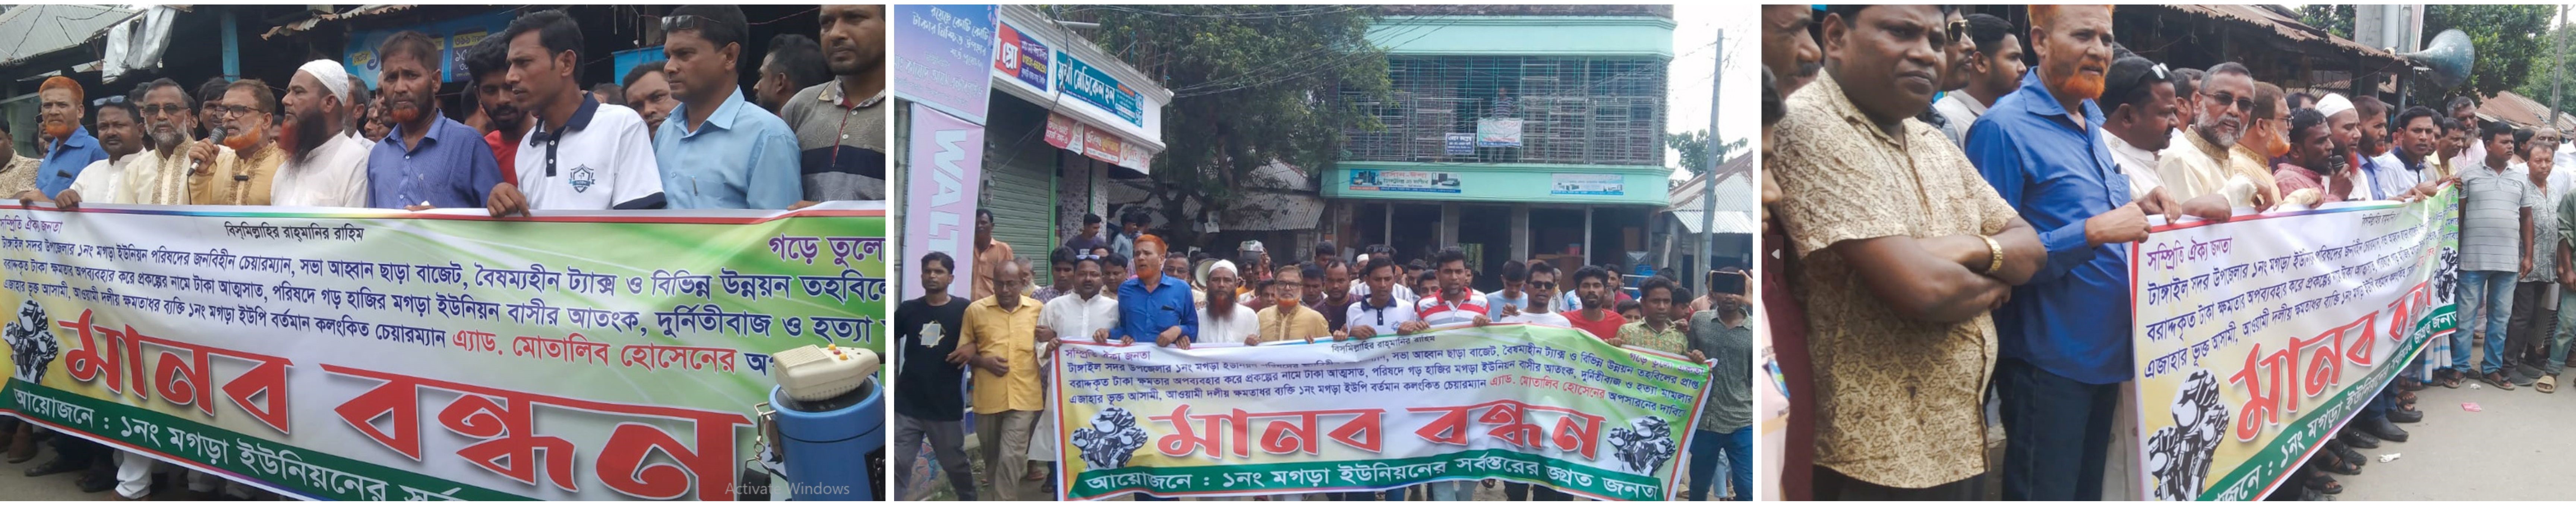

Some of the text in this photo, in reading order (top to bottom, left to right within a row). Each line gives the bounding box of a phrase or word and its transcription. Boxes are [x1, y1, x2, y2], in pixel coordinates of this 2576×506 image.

[40, 221, 63, 234] জনতা
[333, 223, 364, 242] রাহিম
[769, 233, 821, 265] গড়ে
[2188, 236, 2208, 263] ঐক্য
[1, 236, 23, 252] টাঙ্গাইল
[26, 240, 42, 252] সদর
[44, 237, 75, 257] উপজেলার
[78, 243, 93, 259] ১নং
[97, 245, 115, 262] মগড়া
[116, 243, 148, 263] ইউনিয়ন
[151, 245, 190, 265] পরিষদের
[194, 248, 236, 271] জনবিহীন
[239, 255, 295, 278] চেয়ারম্যান,
[299, 258, 323, 276] সভা
[378, 262, 410, 285] ছাড়া
[415, 261, 468, 290] বাজেট,
[474, 262, 562, 293] বৈষম্যহীন
[560, 266, 618, 296] ট্যাক্স
[626, 276, 643, 294] ও
[650, 269, 713, 300] বিভিন্ন
[719, 268, 793, 301] উন্নয়ন
[2147, 276, 2188, 306] টাঙ্গাইল
[2190, 273, 2210, 294] সদর
[2252, 261, 2268, 277] ১নং
[31, 258, 48, 274] টাকা
[50, 263, 73, 277] ক্ষমতার
[75, 265, 116, 283] অপব্যবহার
[119, 271, 135, 285] করে
[138, 271, 168, 289] প্রকল্পের
[170, 275, 190, 291] নামে
[193, 274, 215, 294] টাকা
[218, 280, 268, 303] আত্মসাত,
[272, 280, 316, 304] পরিষদে
[321, 287, 341, 310] গড়
[345, 286, 386, 311] হাজির
[391, 295, 431, 318] মগড়া
[436, 292, 501, 323] ইউনিয়ন
[506, 298, 561, 327] বাসীর
[560, 307, 647, 336] আতংক,
[782, 317, 801, 337] ও
[810, 315, 874, 345] হত্যা
[2146, 311, 2196, 342] বরাদ্দকৃত
[2198, 301, 2214, 325] টাকা
[2247, 282, 2287, 304] অপব্যবহার
[2289, 278, 2305, 293] করে
[3, 279, 25, 293] এজাহার
[42, 280, 71, 301] আসামী,
[73, 286, 99, 303] আওয়ামী
[101, 287, 120, 306] দলীয়
[123, 294, 161, 313] ক্ষমতাধর
[164, 296, 185, 315] ব্যক্তি
[188, 303, 206, 320] ১নং
[208, 305, 235, 325] মগড়া
[238, 304, 266, 327] ইউপি
[270, 309, 310, 331] বর্তমান
[314, 314, 370, 337] কলংকিত
[375, 324, 446, 348] চেয়ারম্যান
[513, 332, 611, 367] মোতালিব
[621, 342, 738, 374] হোসেনের
[1067, 362, 1102, 374] টাঙ্গাইল
[1105, 363, 1126, 372] সদর
[1128, 364, 1171, 373] উপজেলার
[1176, 364, 1193, 373] ১নং
[1195, 362, 1219, 372] মগড়া
[1392, 351, 1409, 361] সভা
[1446, 349, 1465, 360] ছাড়া
[1569, 352, 1577, 361] ও
[1580, 351, 1604, 368] বিভিন্ন
[1607, 359, 1634, 375] উন্নয়ন
[1638, 369, 1678, 384] তহবিলের
[1124, 351, 1150, 361] জনতা
[2144, 348, 2188, 378] এজাহার
[2228, 310, 2379, 442] মানব
[1068, 378, 1109, 392] বরাদ্দকৃত
[1112, 376, 1134, 386] টাকা
[1137, 377, 1169, 386] ক্ষমতার
[1173, 377, 1220, 386] অপব্যবহার
[1224, 375, 1242, 384] করে
[1245, 372, 1279, 383] প্রকল্পের
[1281, 370, 1301, 380] নামে
[1304, 369, 1323, 379] টাকা
[1372, 364, 1404, 377] পরিষদে
[1408, 366, 1422, 377] গড়
[1425, 363, 1451, 374] হাজির
[1455, 364, 1478, 375] মগড়া
[1481, 360, 1515, 372] ইউনিয়ন
[1519, 358, 1541, 373] বাসীর
[1636, 383, 1658, 395] হত্যা
[1661, 388, 1693, 403] মামলার
[1069, 394, 1103, 405] এজাহার
[1166, 388, 1203, 399] আওয়ামী
[1207, 387, 1229, 398] দলীয়
[1232, 388, 1271, 397] ক্ষমতাধর
[1274, 383, 1295, 396] ব্যক্তি
[1299, 385, 1316, 395] ১নং
[1318, 384, 1341, 395] মগড়া
[1344, 381, 1367, 393] ইউপি
[1370, 380, 1399, 392] বর্তমান
[1404, 379, 1440, 392] কলংকিত
[1444, 379, 1486, 390] চেয়ারম্যান
[1520, 375, 1559, 390] মোতালিব
[1563, 381, 1606, 400] হোসেনের
[1609, 392, 1657, 411] অপসারনের
[57, 308, 755, 500] মানব বন্ধন
[13, 388, 390, 501] আয়োজনে ১নং মগড়া ইউনিয়নের
[1149, 399, 1607, 461] মানব বন্ধন
[2280, 400, 2343, 468] ১নং মগড়া
[1084, 452, 1660, 500] আয়োজনে ১নং মগড়া ইউনিয়নের সর্বস্তরের জনতা
